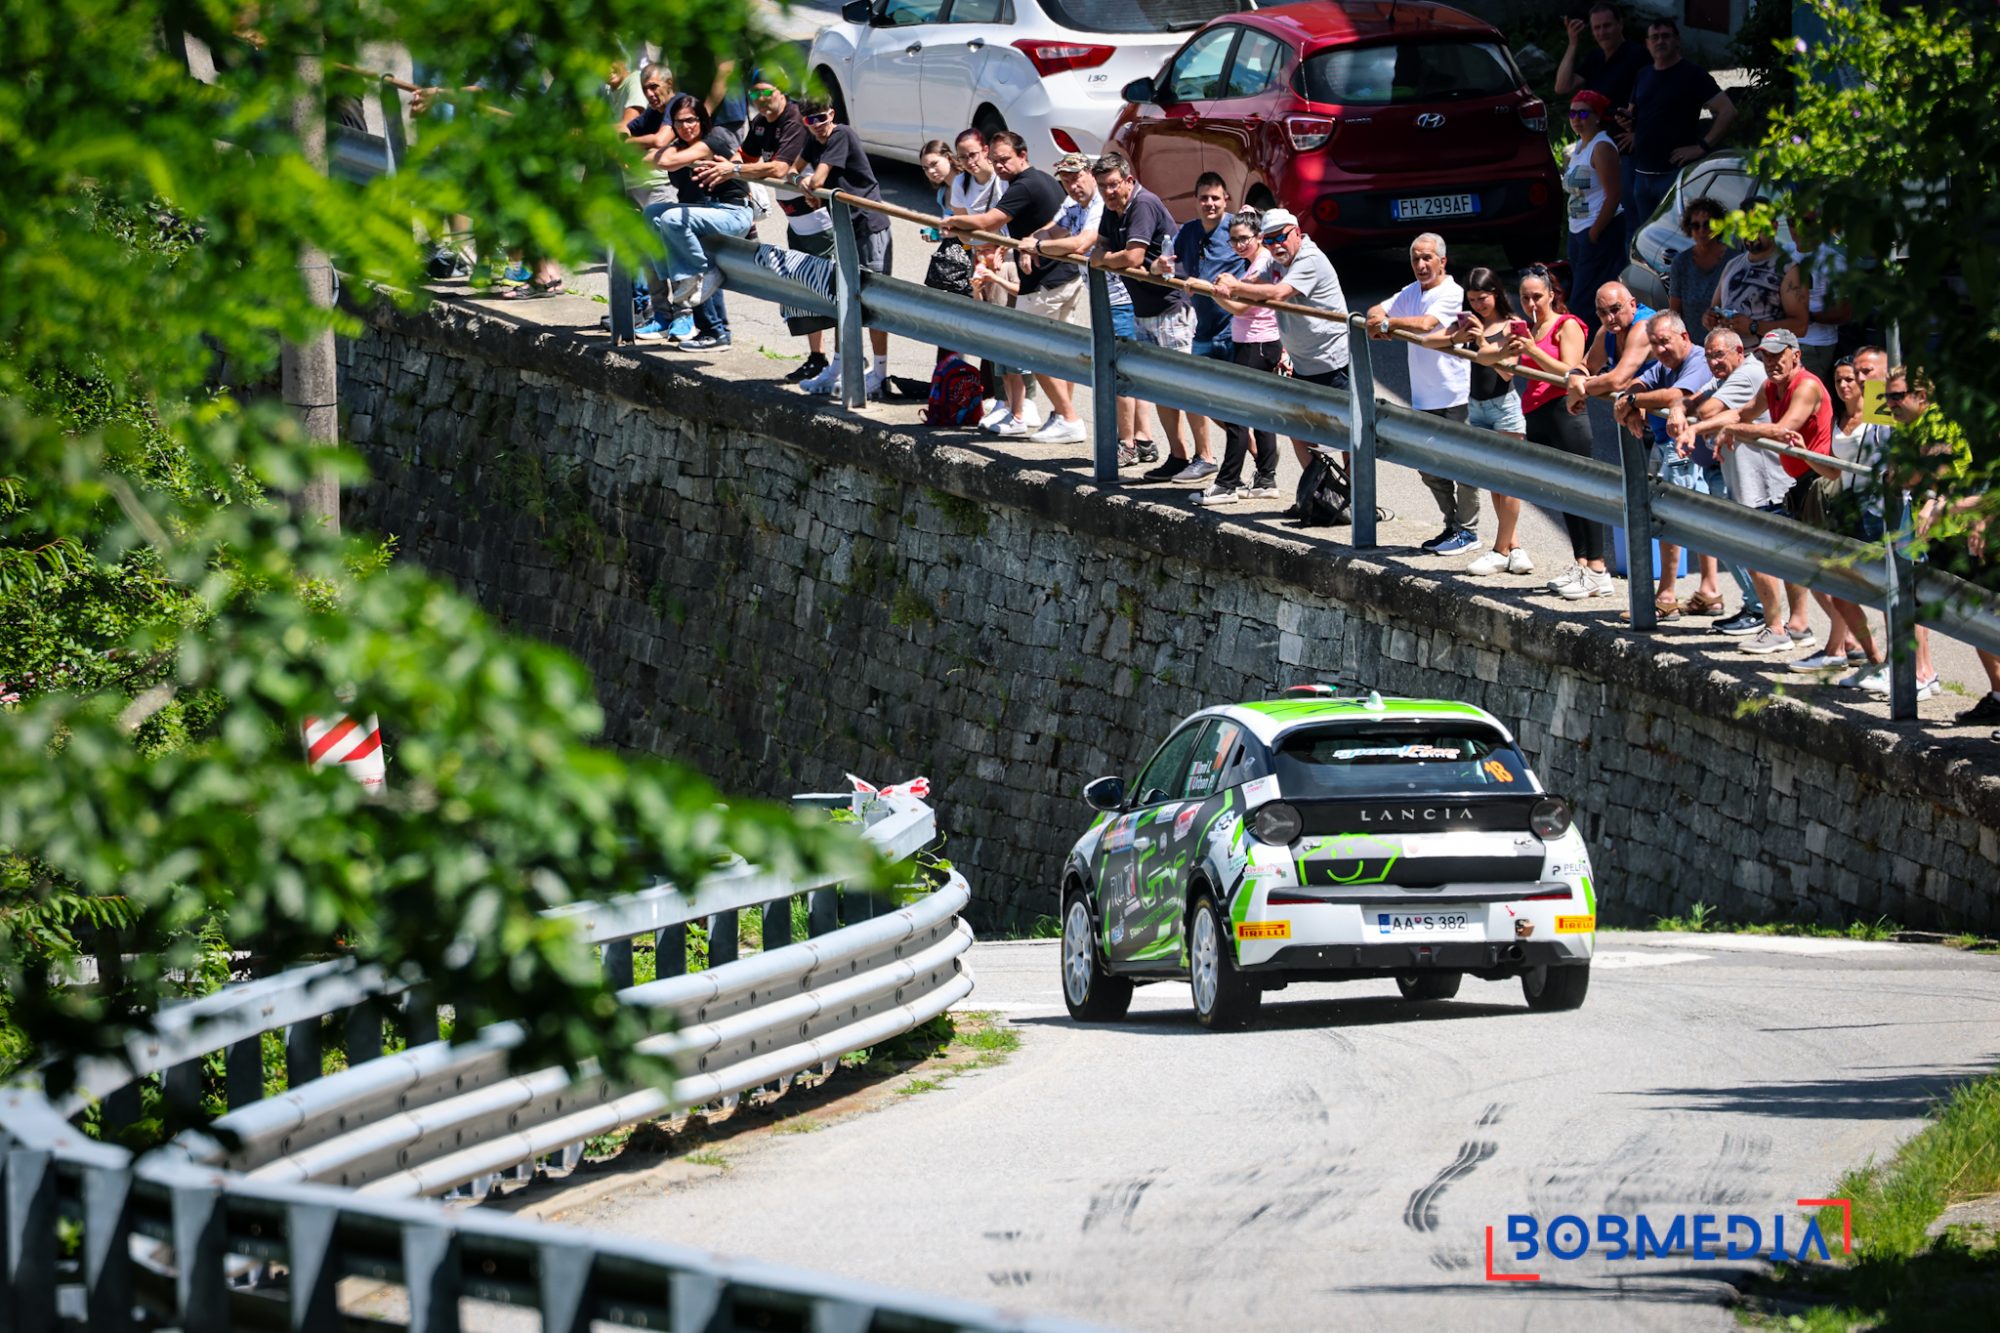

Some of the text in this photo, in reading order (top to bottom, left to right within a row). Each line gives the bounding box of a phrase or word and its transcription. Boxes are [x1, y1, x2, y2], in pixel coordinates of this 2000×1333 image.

[1484, 760, 1514, 783] 18
[1360, 807, 1474, 822] LANCIA
[1238, 923, 1286, 938] PIRELLI
